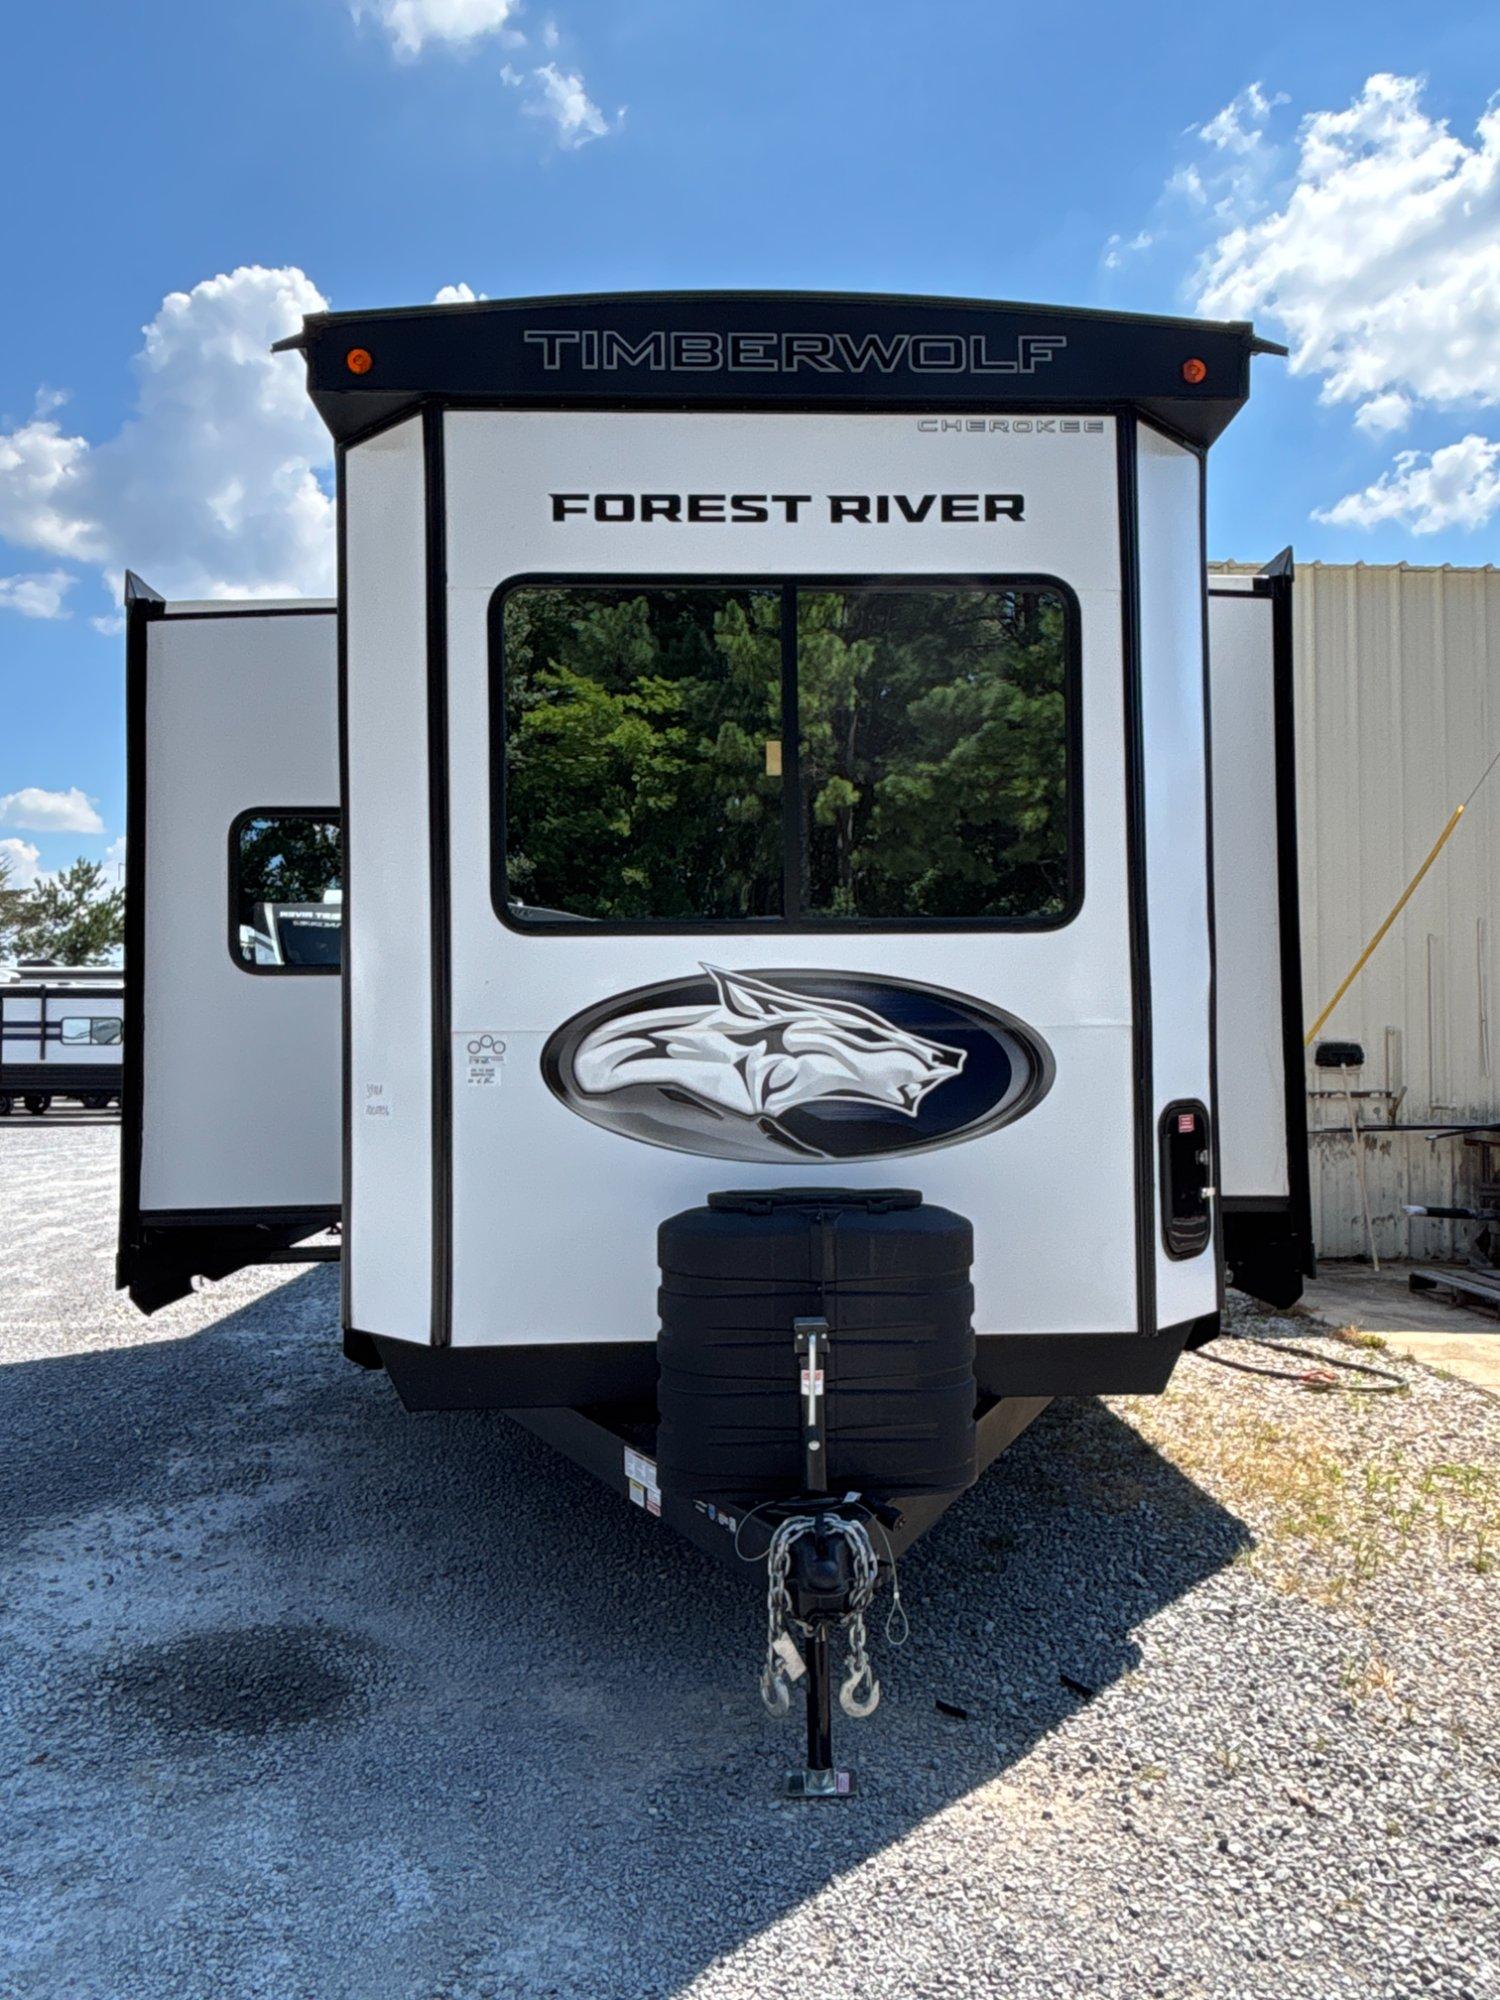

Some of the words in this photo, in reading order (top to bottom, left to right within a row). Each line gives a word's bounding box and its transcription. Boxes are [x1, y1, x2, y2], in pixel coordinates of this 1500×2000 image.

[523, 329, 1068, 375] TIMBERWOLF
[916, 418, 1105, 434] CHEROKEE
[548, 493, 812, 523] FOREST
[826, 493, 1027, 523] RIVER
